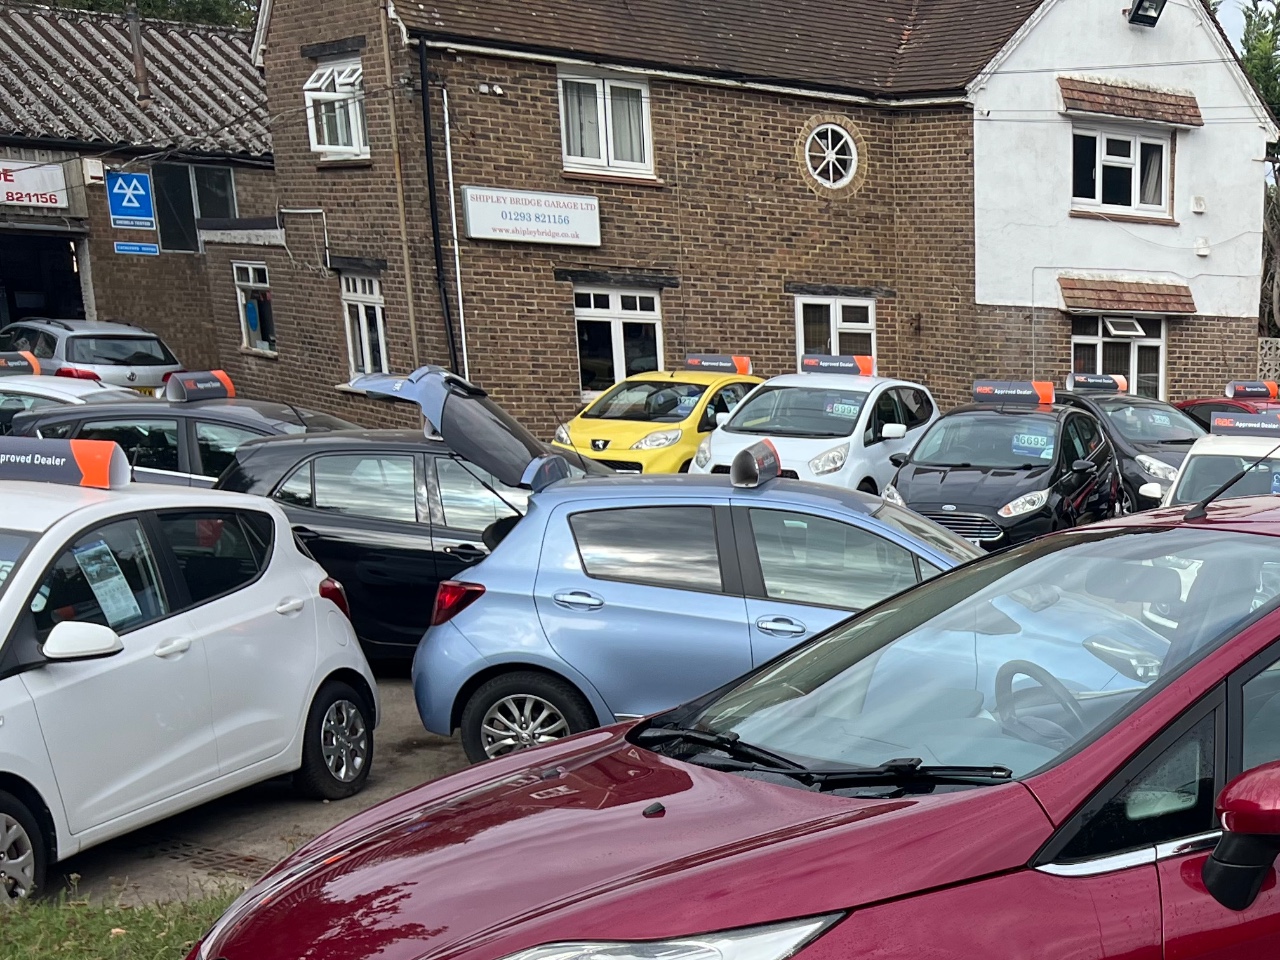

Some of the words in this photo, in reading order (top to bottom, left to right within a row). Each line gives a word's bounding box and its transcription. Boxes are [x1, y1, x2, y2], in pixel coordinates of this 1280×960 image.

[6, 191, 58, 204] 821156
[470, 194, 508, 204] SHIPLEY
[510, 197, 542, 207] BRIDGE
[544, 200, 579, 210] GARAGE
[580, 202, 596, 211] LTD
[501, 211, 531, 221] 01293
[535, 213, 570, 225] 821156
[492, 226, 580, 239] www.shipleybridge.co.uk
[1236, 421, 1260, 429] Approved
[0, 454, 32, 464] proved
[34, 454, 66, 466] Dealer
